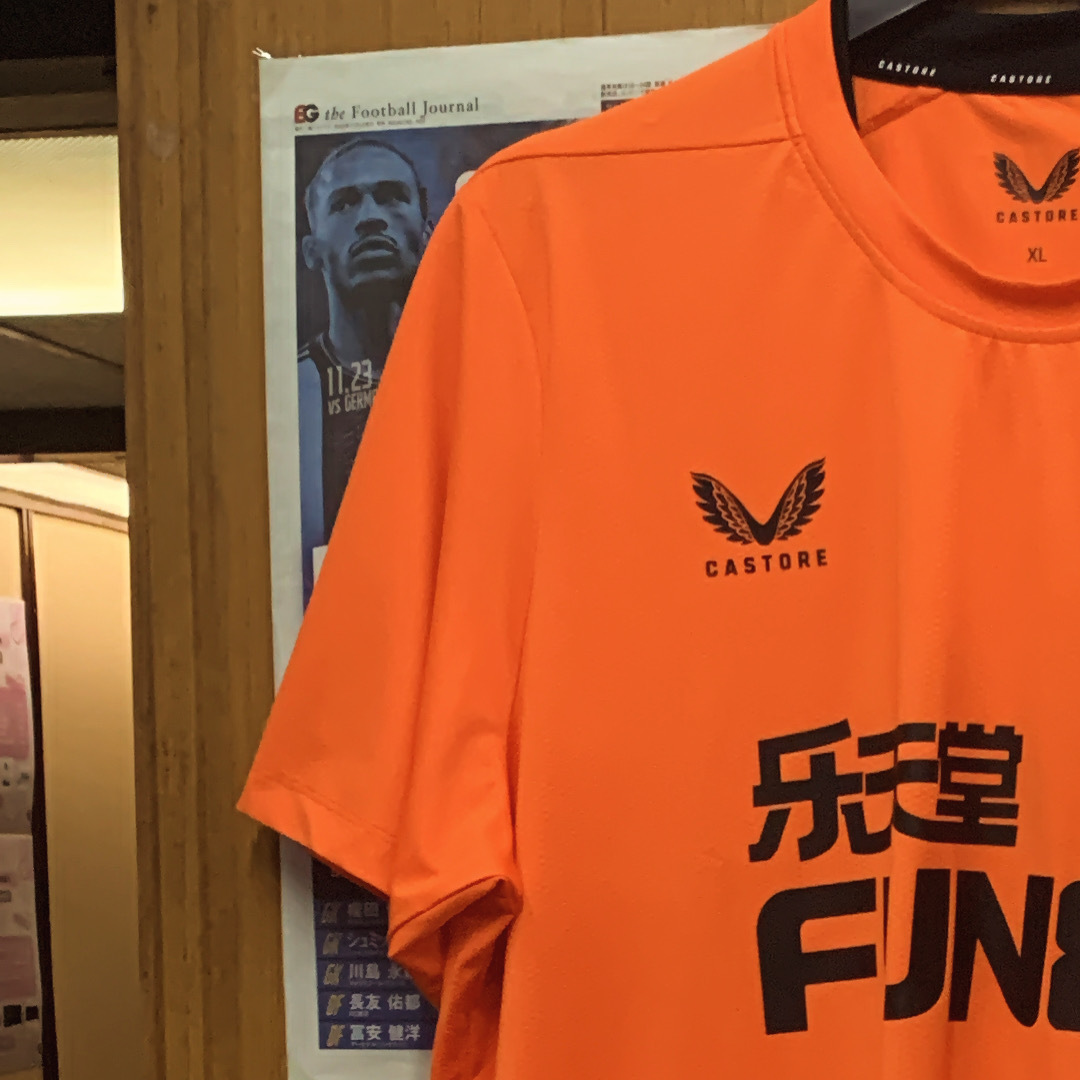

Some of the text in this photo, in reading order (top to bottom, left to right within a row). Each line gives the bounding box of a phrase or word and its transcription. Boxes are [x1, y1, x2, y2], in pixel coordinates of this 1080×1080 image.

[878, 59, 937, 77] CASTORE
[990, 73, 1052, 85] CASTORE
[324, 106, 346, 121] the
[351, 101, 416, 119] Football
[422, 97, 479, 117] Journal
[996, 209, 1078, 224] CASTORE
[1027, 246, 1048, 263] XL
[327, 359, 373, 397] 11.23
[328, 398, 341, 415] VS
[705, 548, 828, 578] CASTORE
[748, 718, 1023, 862] 乐天堂
